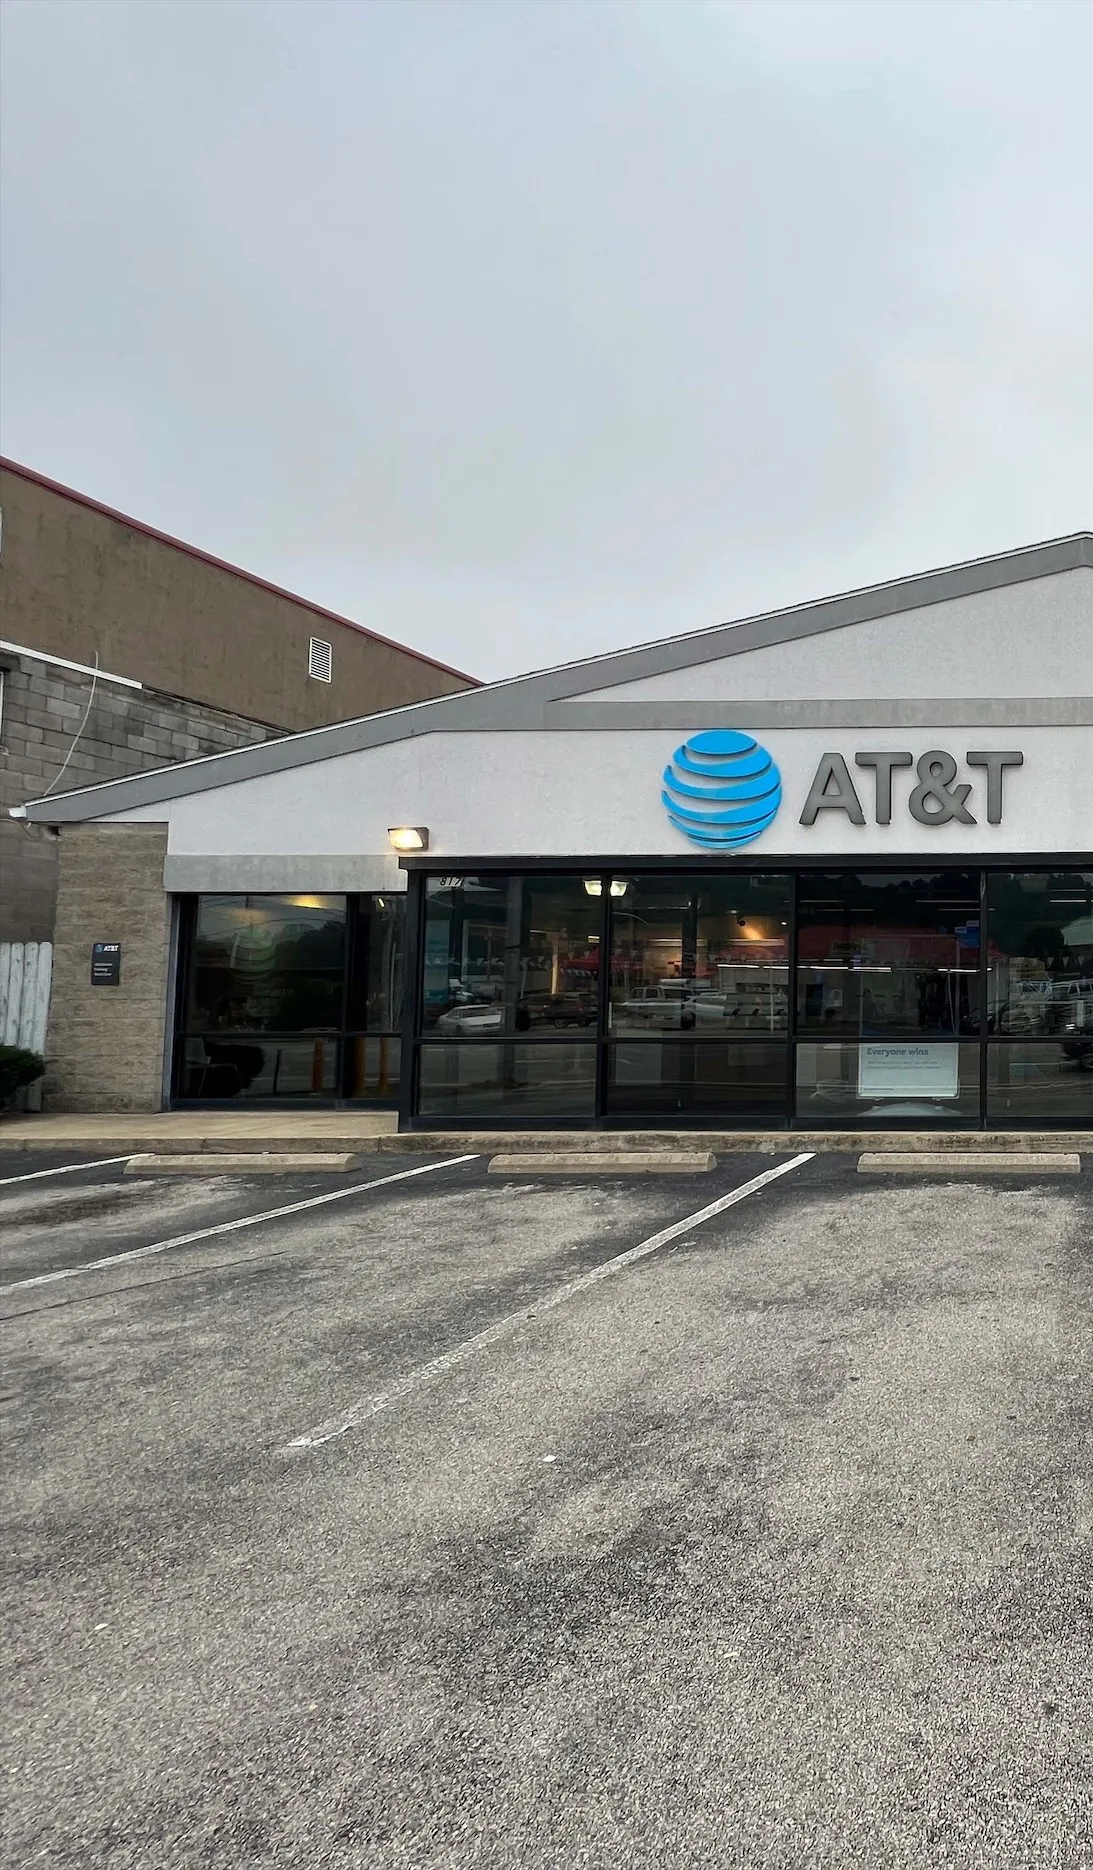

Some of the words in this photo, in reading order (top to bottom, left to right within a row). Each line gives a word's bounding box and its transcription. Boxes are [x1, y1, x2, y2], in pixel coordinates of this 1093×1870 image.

[798, 750, 1024, 826] AT&T
[440, 876, 462, 886] 817
[866, 1047, 907, 1057] Everyone
[908, 1047, 929, 1056] wins
